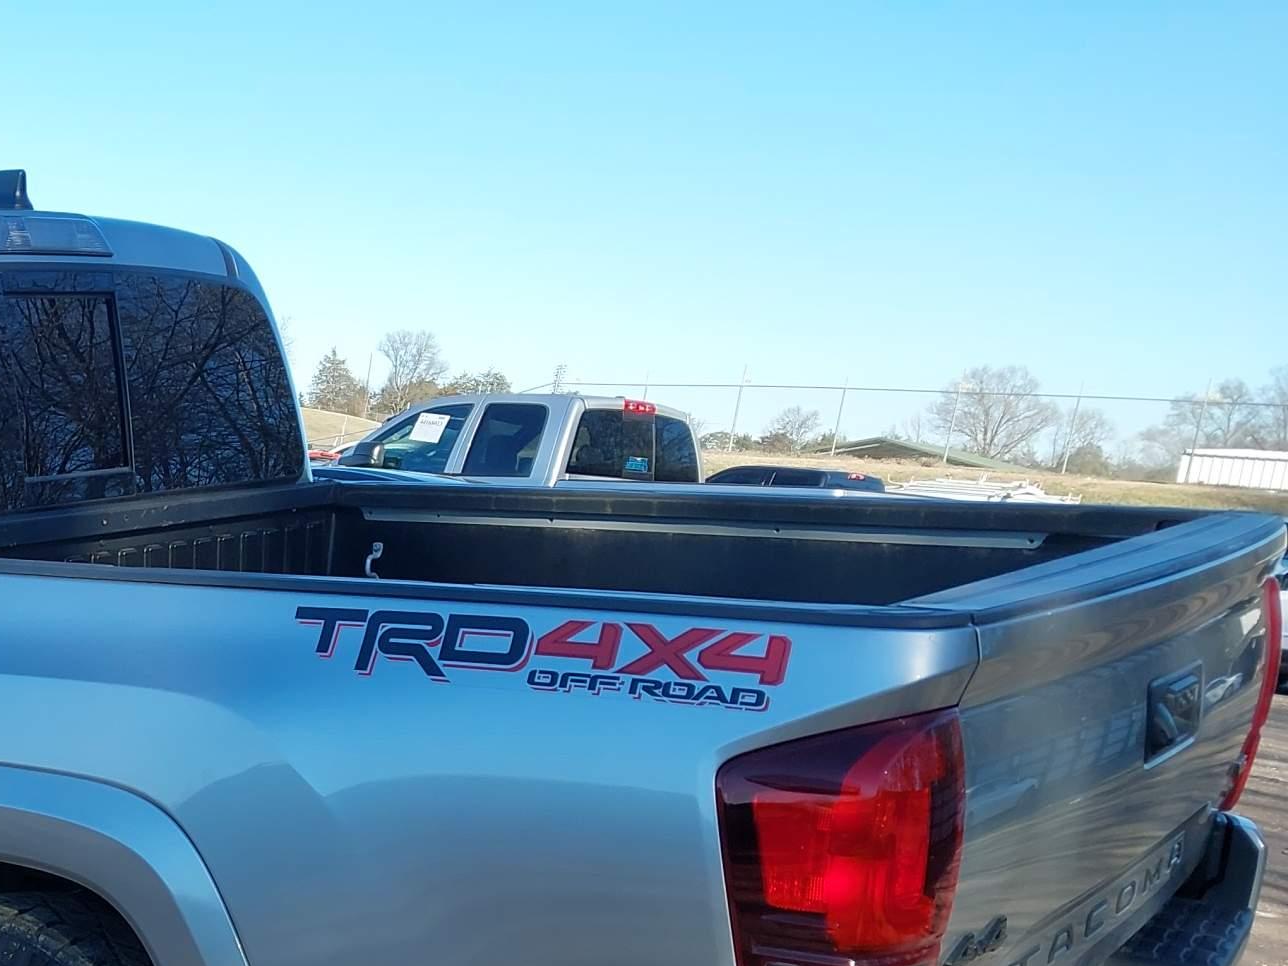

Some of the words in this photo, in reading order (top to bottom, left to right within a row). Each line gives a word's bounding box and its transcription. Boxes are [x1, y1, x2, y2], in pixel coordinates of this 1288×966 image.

[295, 606, 535, 683] TRD
[534, 619, 793, 687] 4X4
[526, 668, 621, 694] OFF
[626, 678, 770, 712] ROAD
